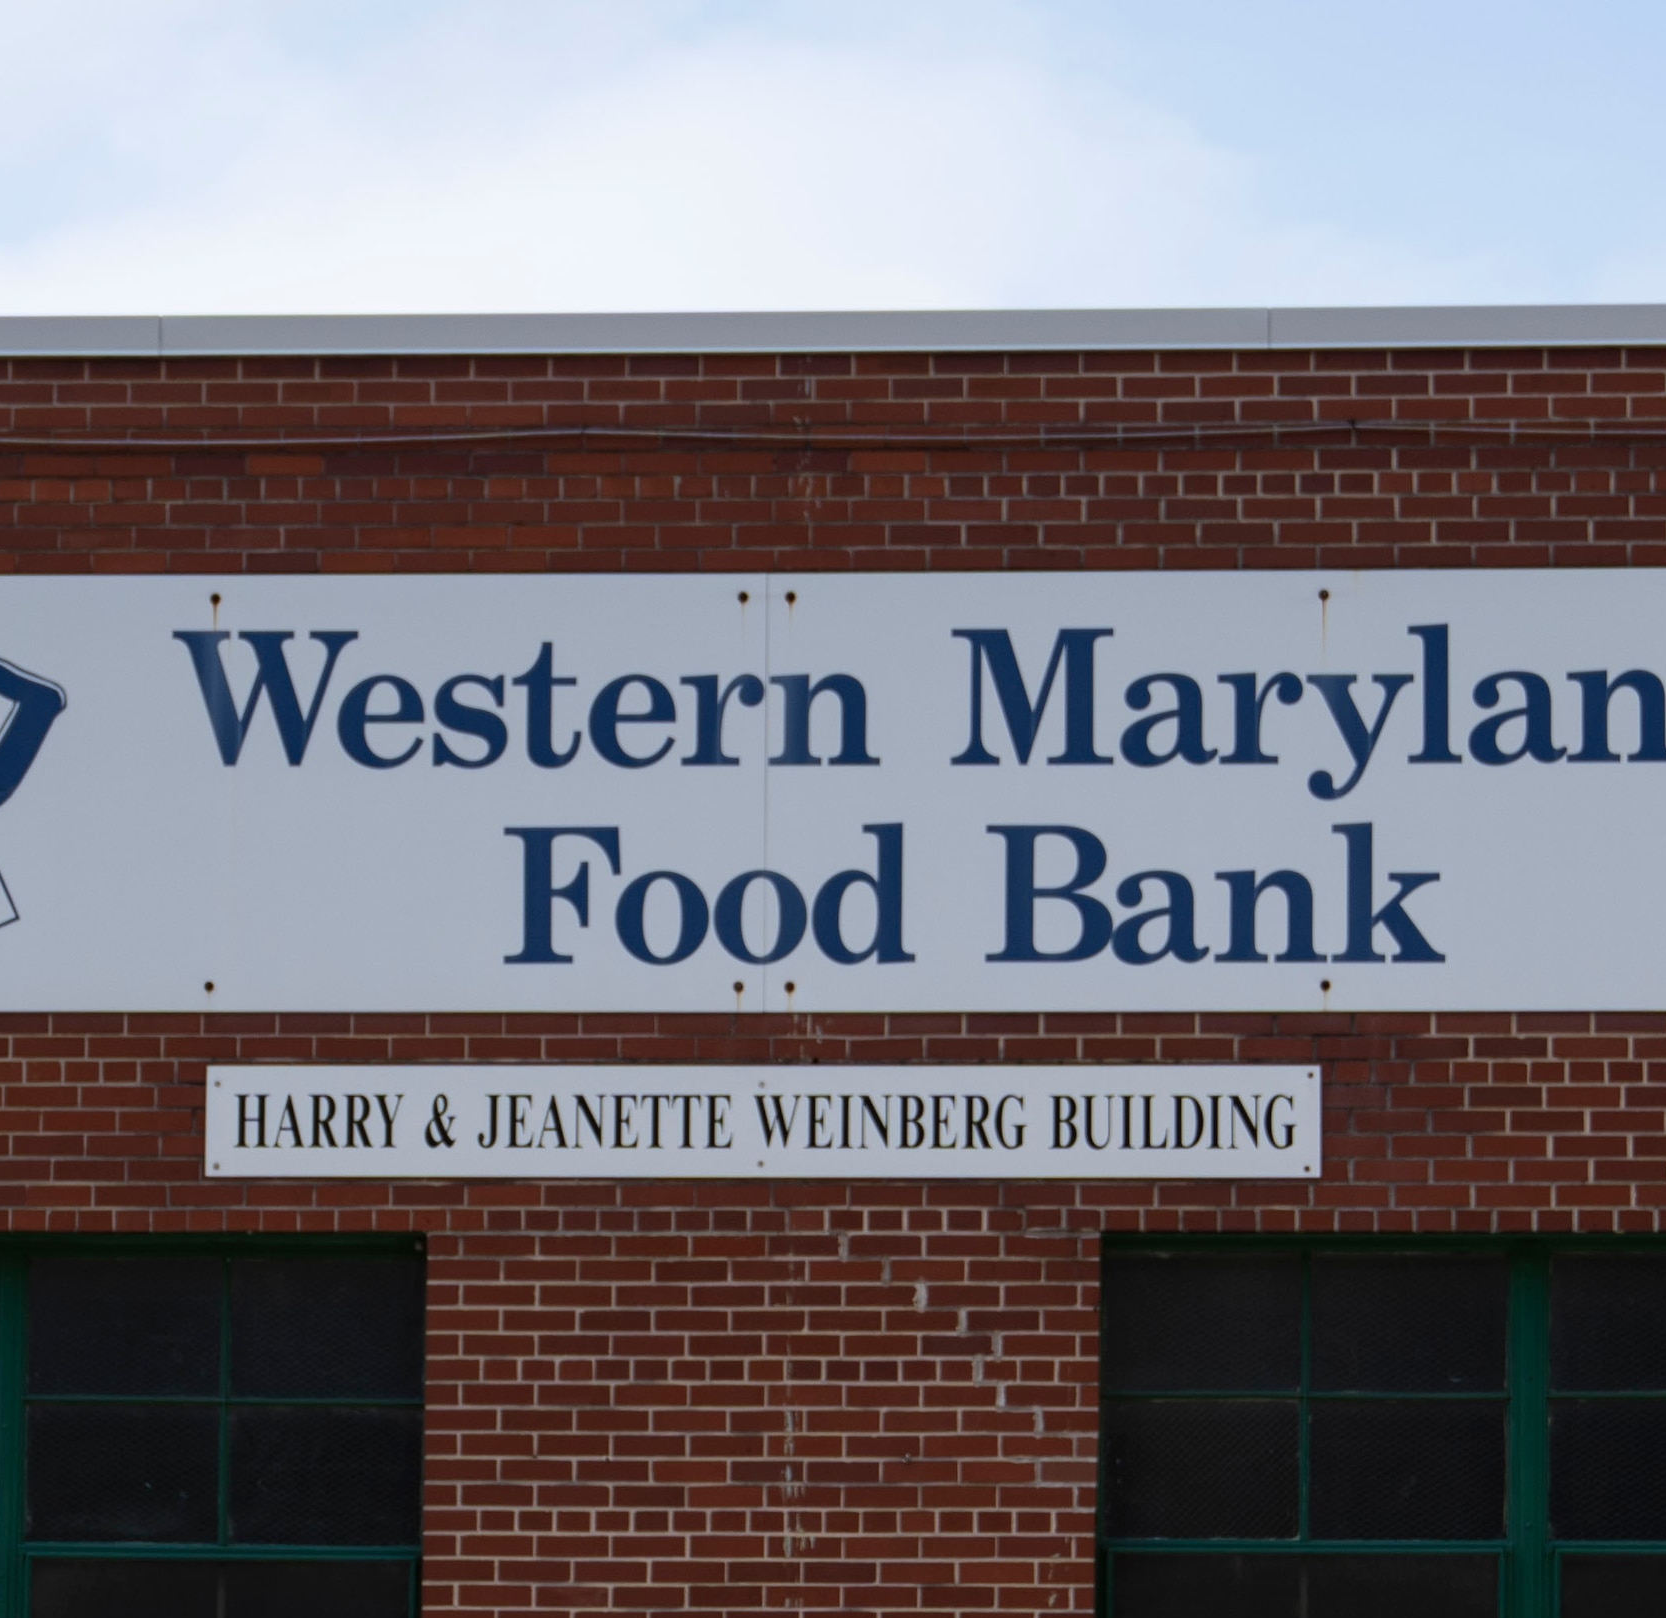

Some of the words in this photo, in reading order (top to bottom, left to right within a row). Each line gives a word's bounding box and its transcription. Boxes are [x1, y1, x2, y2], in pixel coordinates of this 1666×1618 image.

[173, 630, 881, 770] Western
[503, 822, 916, 966] Food
[985, 821, 1446, 966] Bank
[234, 1093, 404, 1149] HARRY
[424, 1093, 457, 1149] &
[477, 1093, 732, 1150] JEANETTE
[754, 1093, 1026, 1150] WEINBERG
[1049, 1093, 1297, 1150] BUILDING
